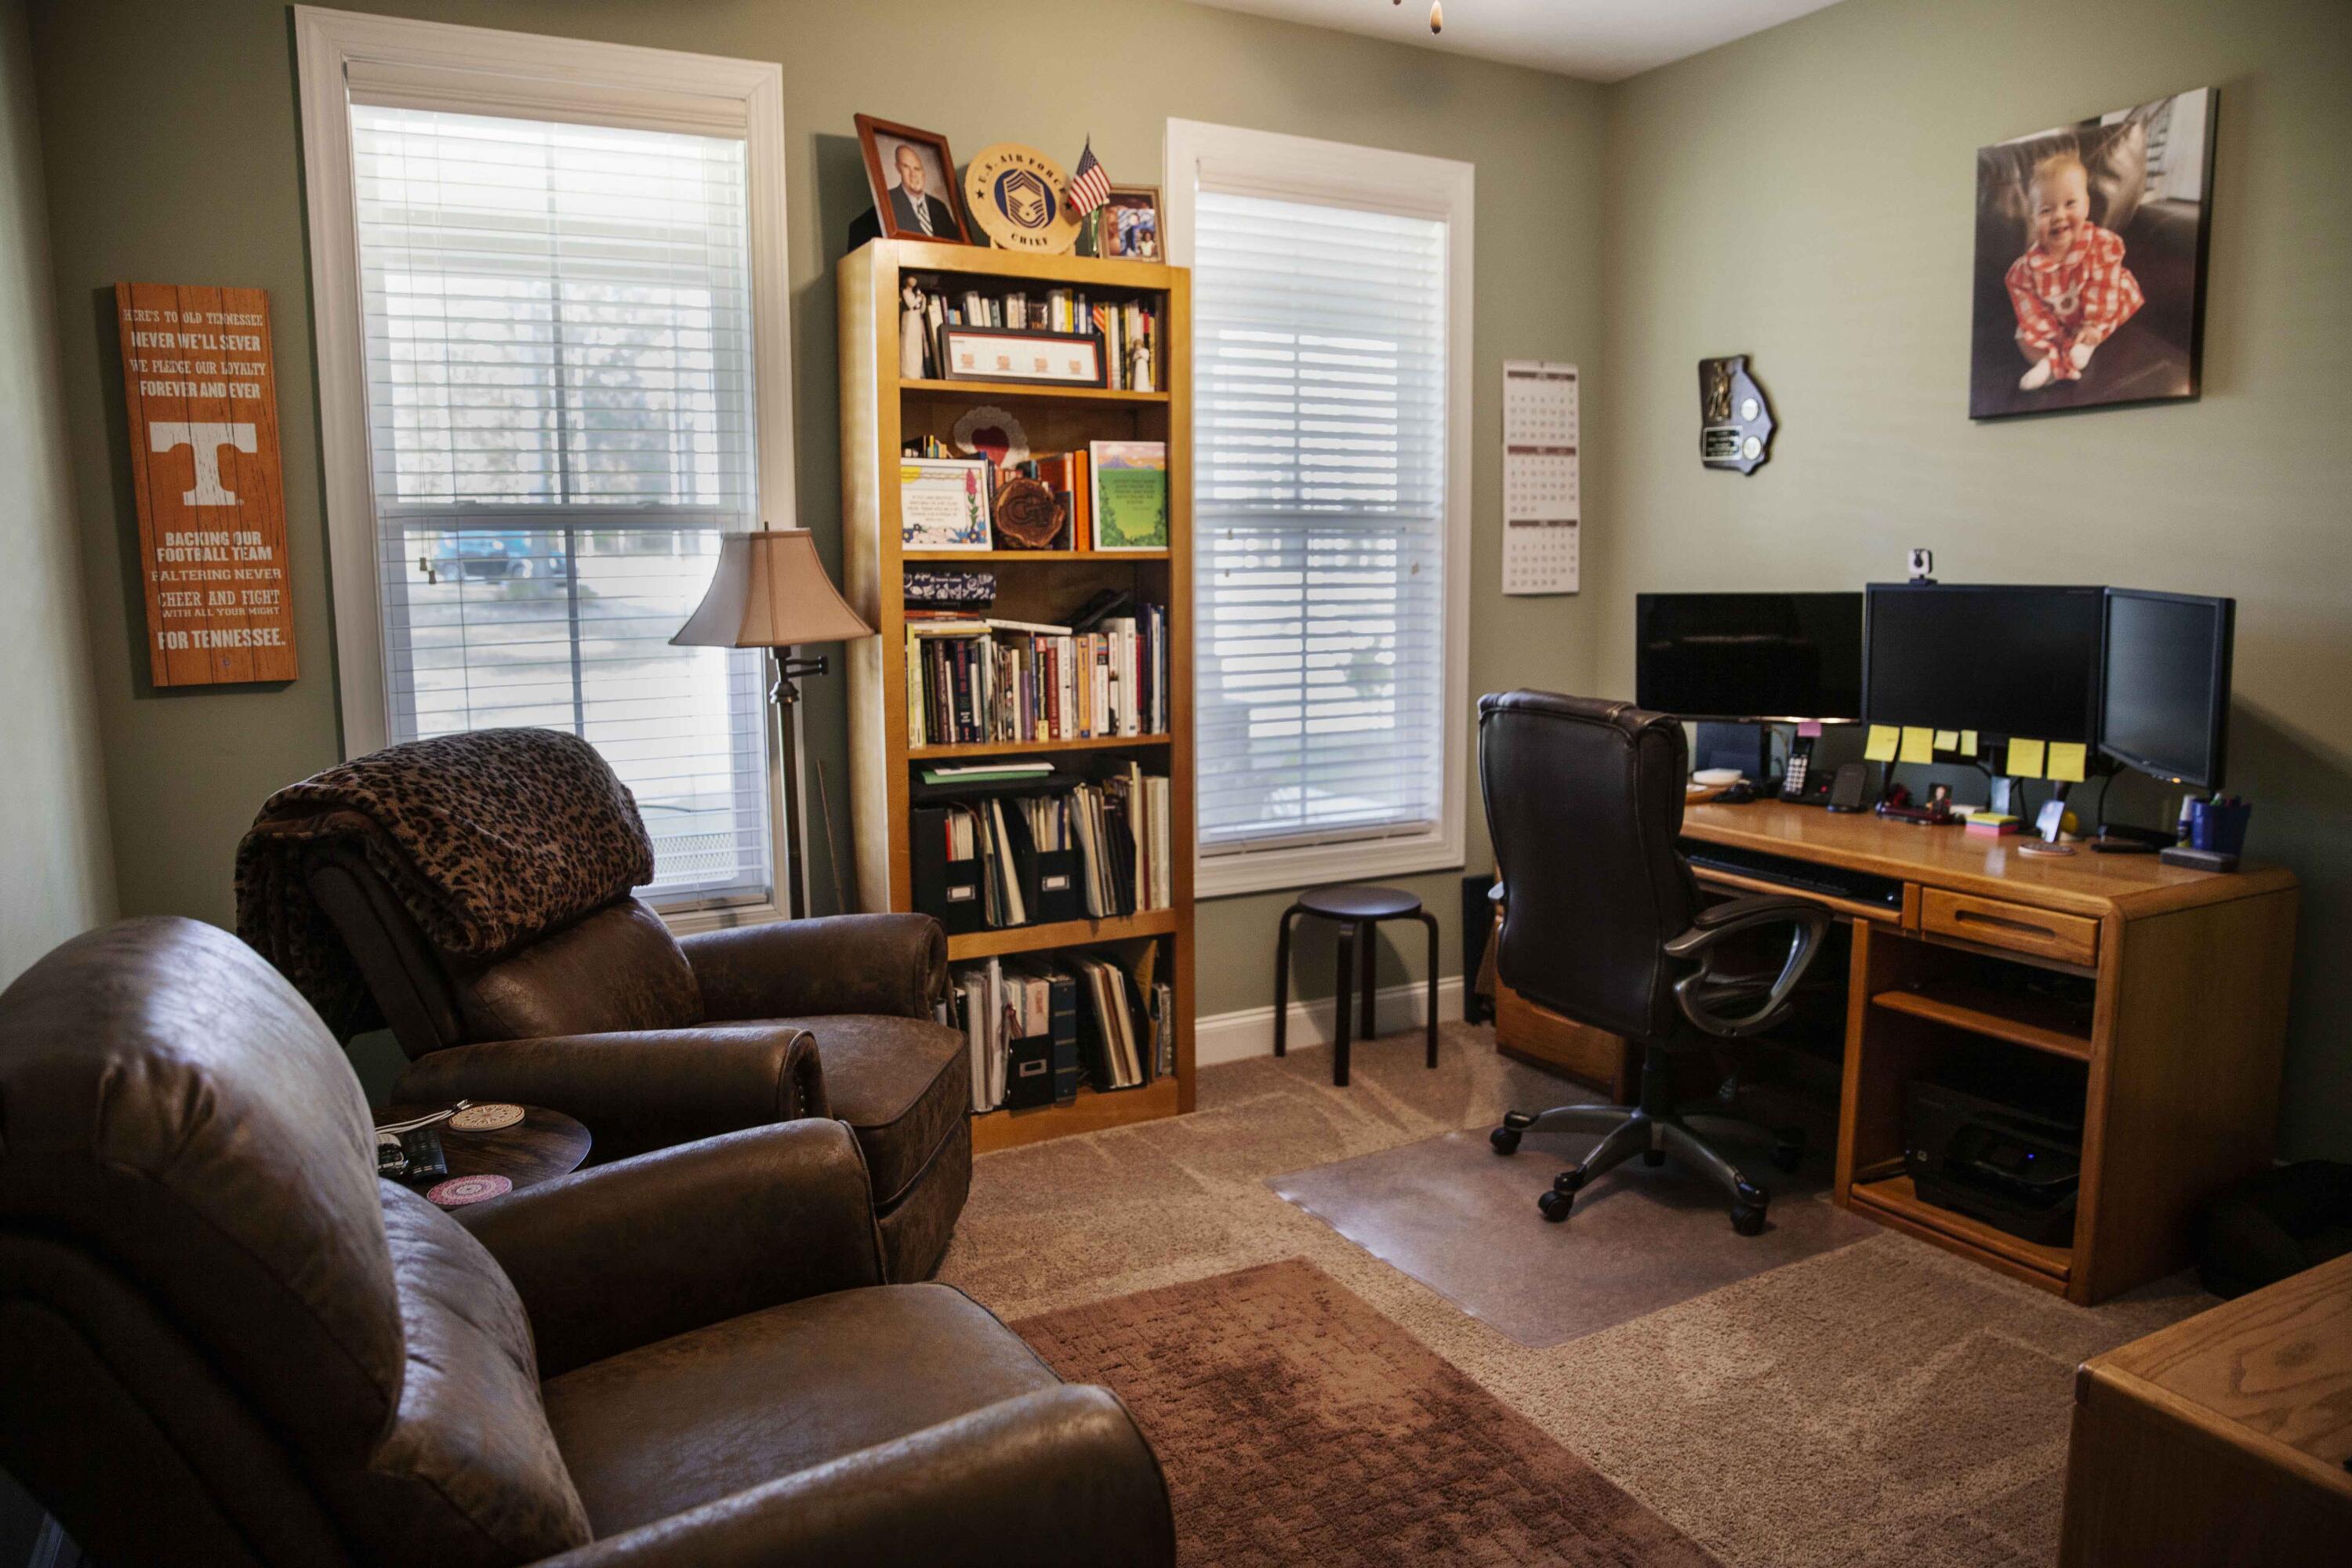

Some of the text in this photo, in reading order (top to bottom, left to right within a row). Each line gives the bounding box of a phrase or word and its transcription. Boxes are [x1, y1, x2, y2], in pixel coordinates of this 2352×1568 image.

[1011, 234, 1047, 245] CHIEF
[123, 309, 263, 327] HERE'S TO OLD TENNESSEE
[131, 331, 260, 351] NEVER WE'LL SEVER
[129, 359, 266, 376] WE PLEDGE OUR LOYALTY
[140, 380, 260, 398] FOREVER AND EVER
[149, 422, 257, 506] T
[165, 531, 262, 546] BACKING OUR
[157, 546, 272, 562] FOOTBALL TEAM
[152, 568, 281, 581] FALTERING NEVER
[158, 590, 280, 607] CHEER AND FIGHT
[162, 607, 280, 618] WITH ALL YOUR MIGHT
[158, 631, 189, 650] FOR
